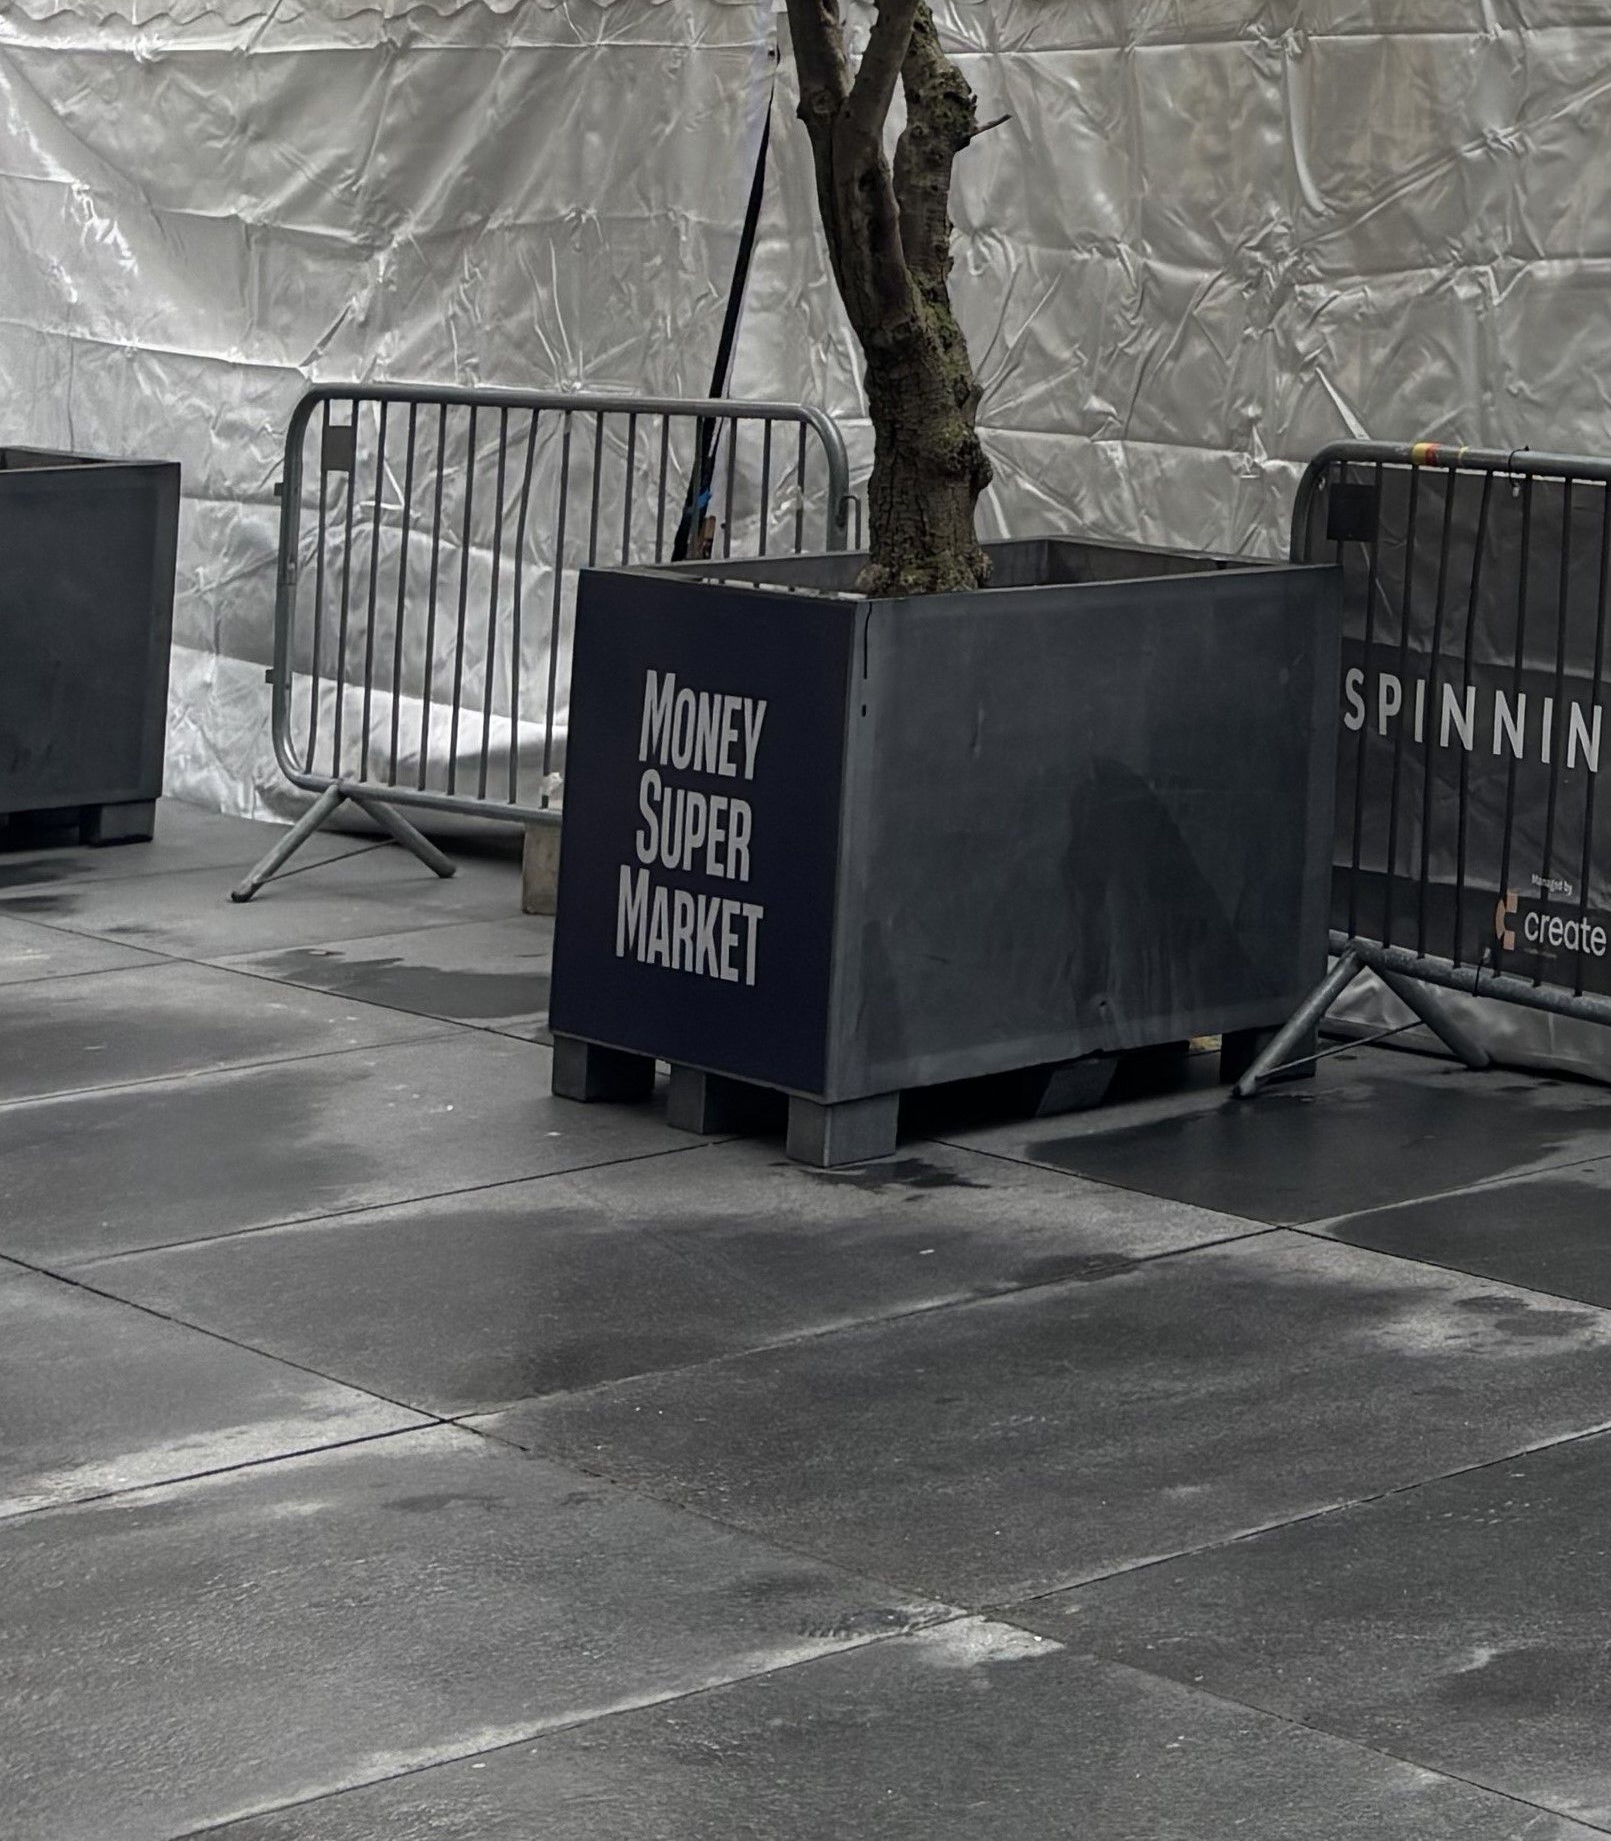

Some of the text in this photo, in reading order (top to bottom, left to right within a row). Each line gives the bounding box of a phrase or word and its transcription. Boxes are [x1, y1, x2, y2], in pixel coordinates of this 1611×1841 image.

[638, 668, 768, 781] MONEY
[635, 768, 753, 883] SUPER
[615, 863, 764, 987] MARKET
[1524, 911, 1608, 957] create
